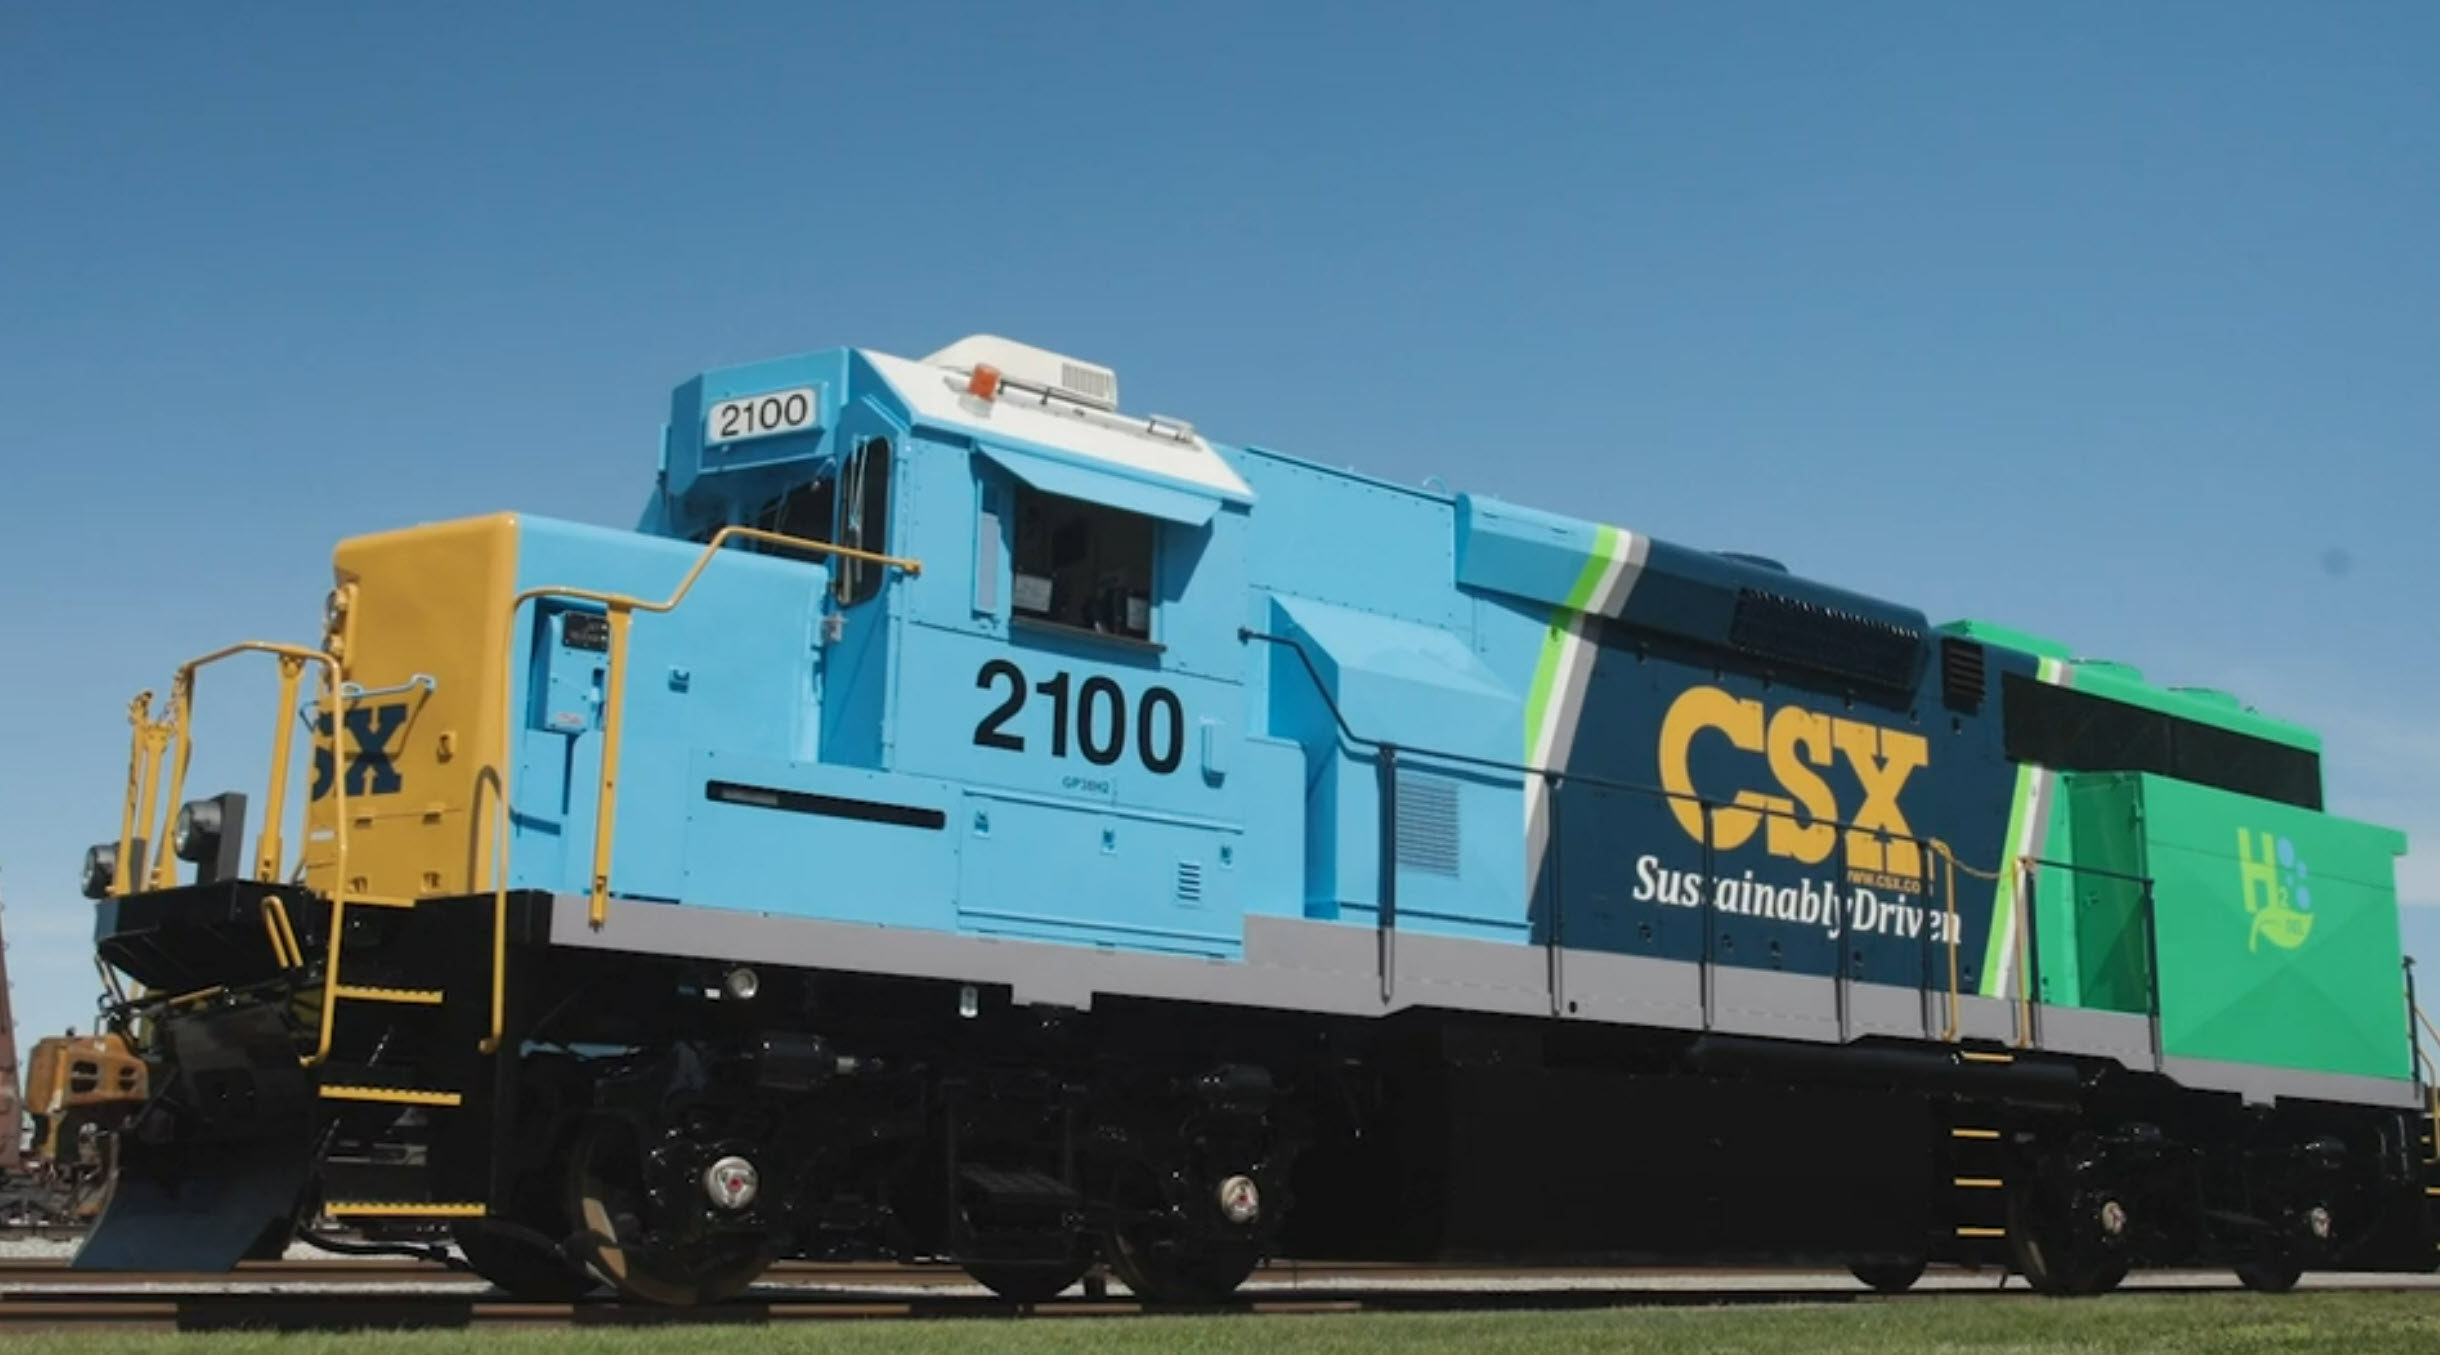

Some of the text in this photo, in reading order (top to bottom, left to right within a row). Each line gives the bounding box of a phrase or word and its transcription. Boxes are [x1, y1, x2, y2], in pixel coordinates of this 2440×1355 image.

[720, 393, 808, 438] 2100
[972, 657, 1184, 775] 2100
[1658, 684, 1935, 882] CSX
